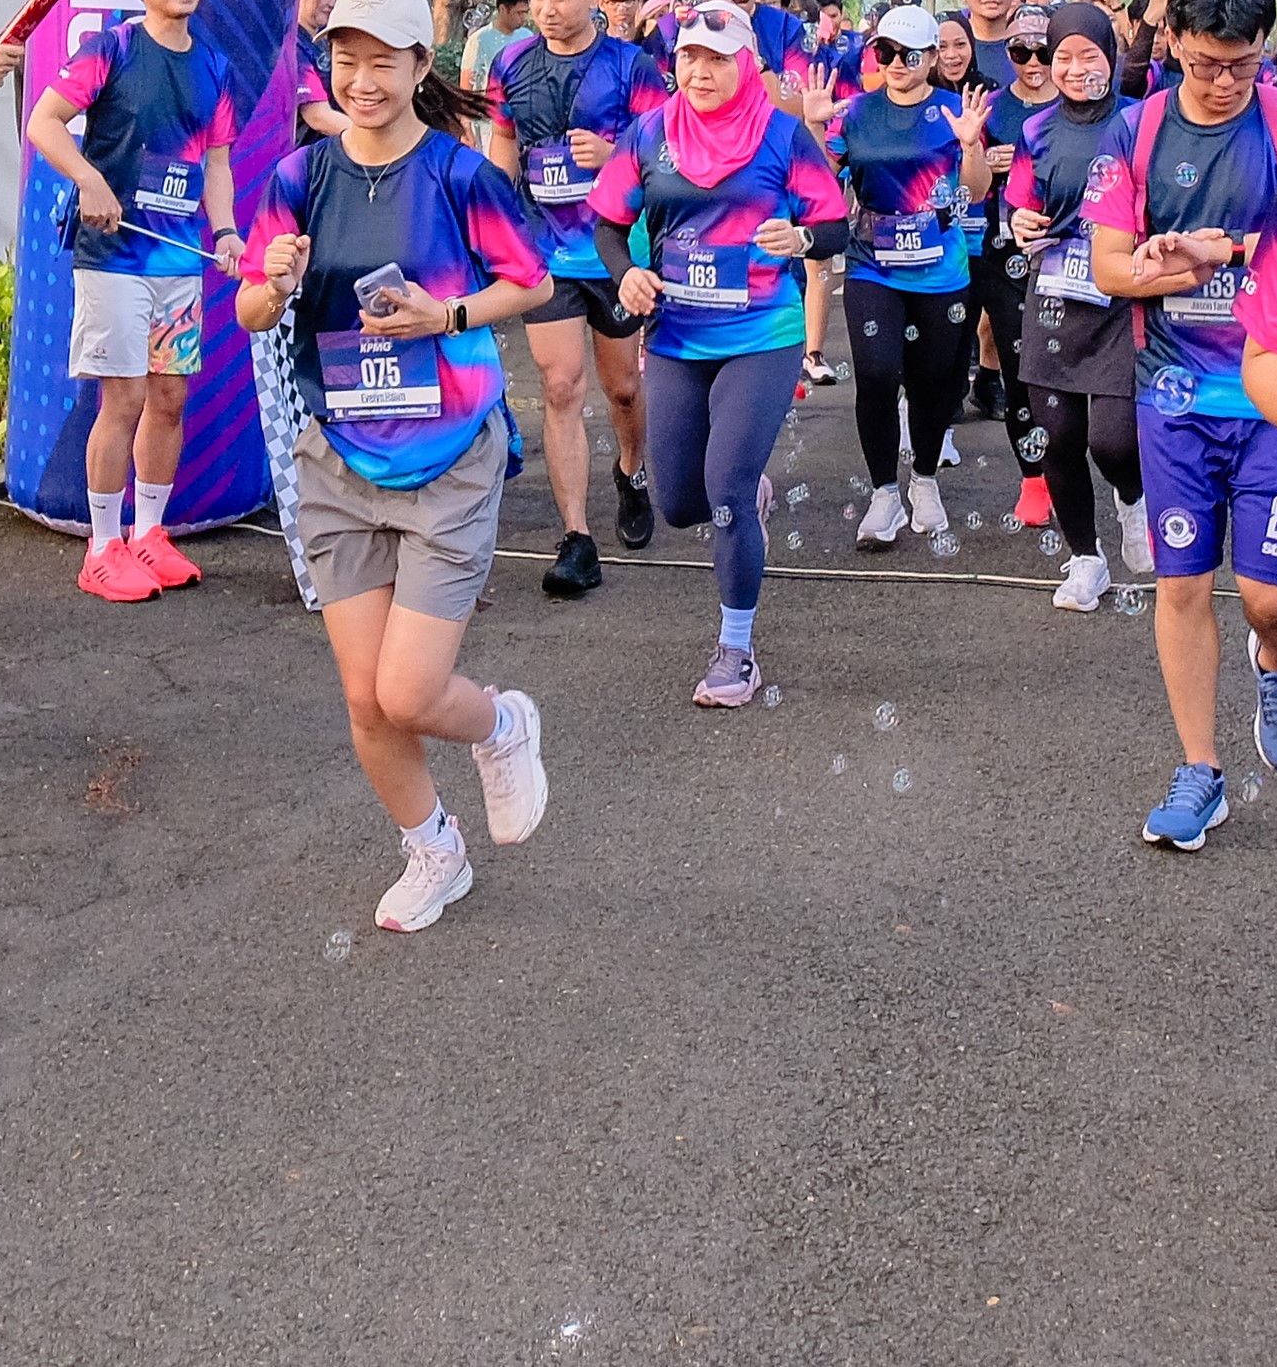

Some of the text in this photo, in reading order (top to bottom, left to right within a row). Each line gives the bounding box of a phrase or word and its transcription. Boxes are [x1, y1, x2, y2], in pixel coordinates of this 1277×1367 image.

[162, 175, 187, 198] 010
[543, 165, 569, 186] 074
[895, 232, 922, 250] 345
[687, 263, 717, 288] 163
[360, 341, 393, 353] KPMG
[360, 356, 401, 388] 075
